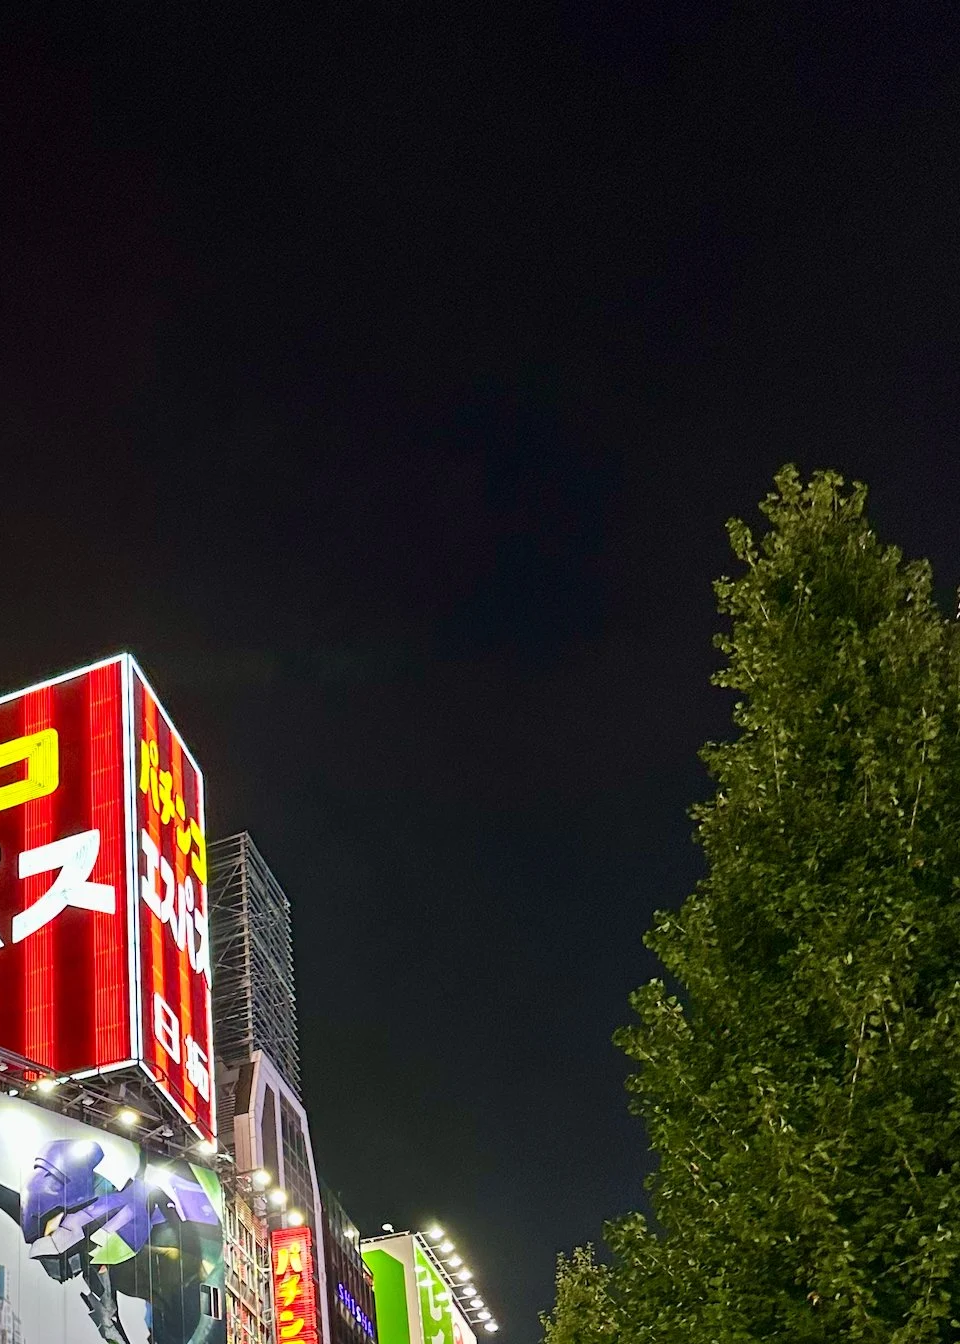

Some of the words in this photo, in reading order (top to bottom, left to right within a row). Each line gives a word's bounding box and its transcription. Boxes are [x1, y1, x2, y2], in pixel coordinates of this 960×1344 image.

[140, 739, 207, 887] パチンコ
[142, 828, 211, 990] エスパス
[338, 1283, 374, 1339] SHISHA
